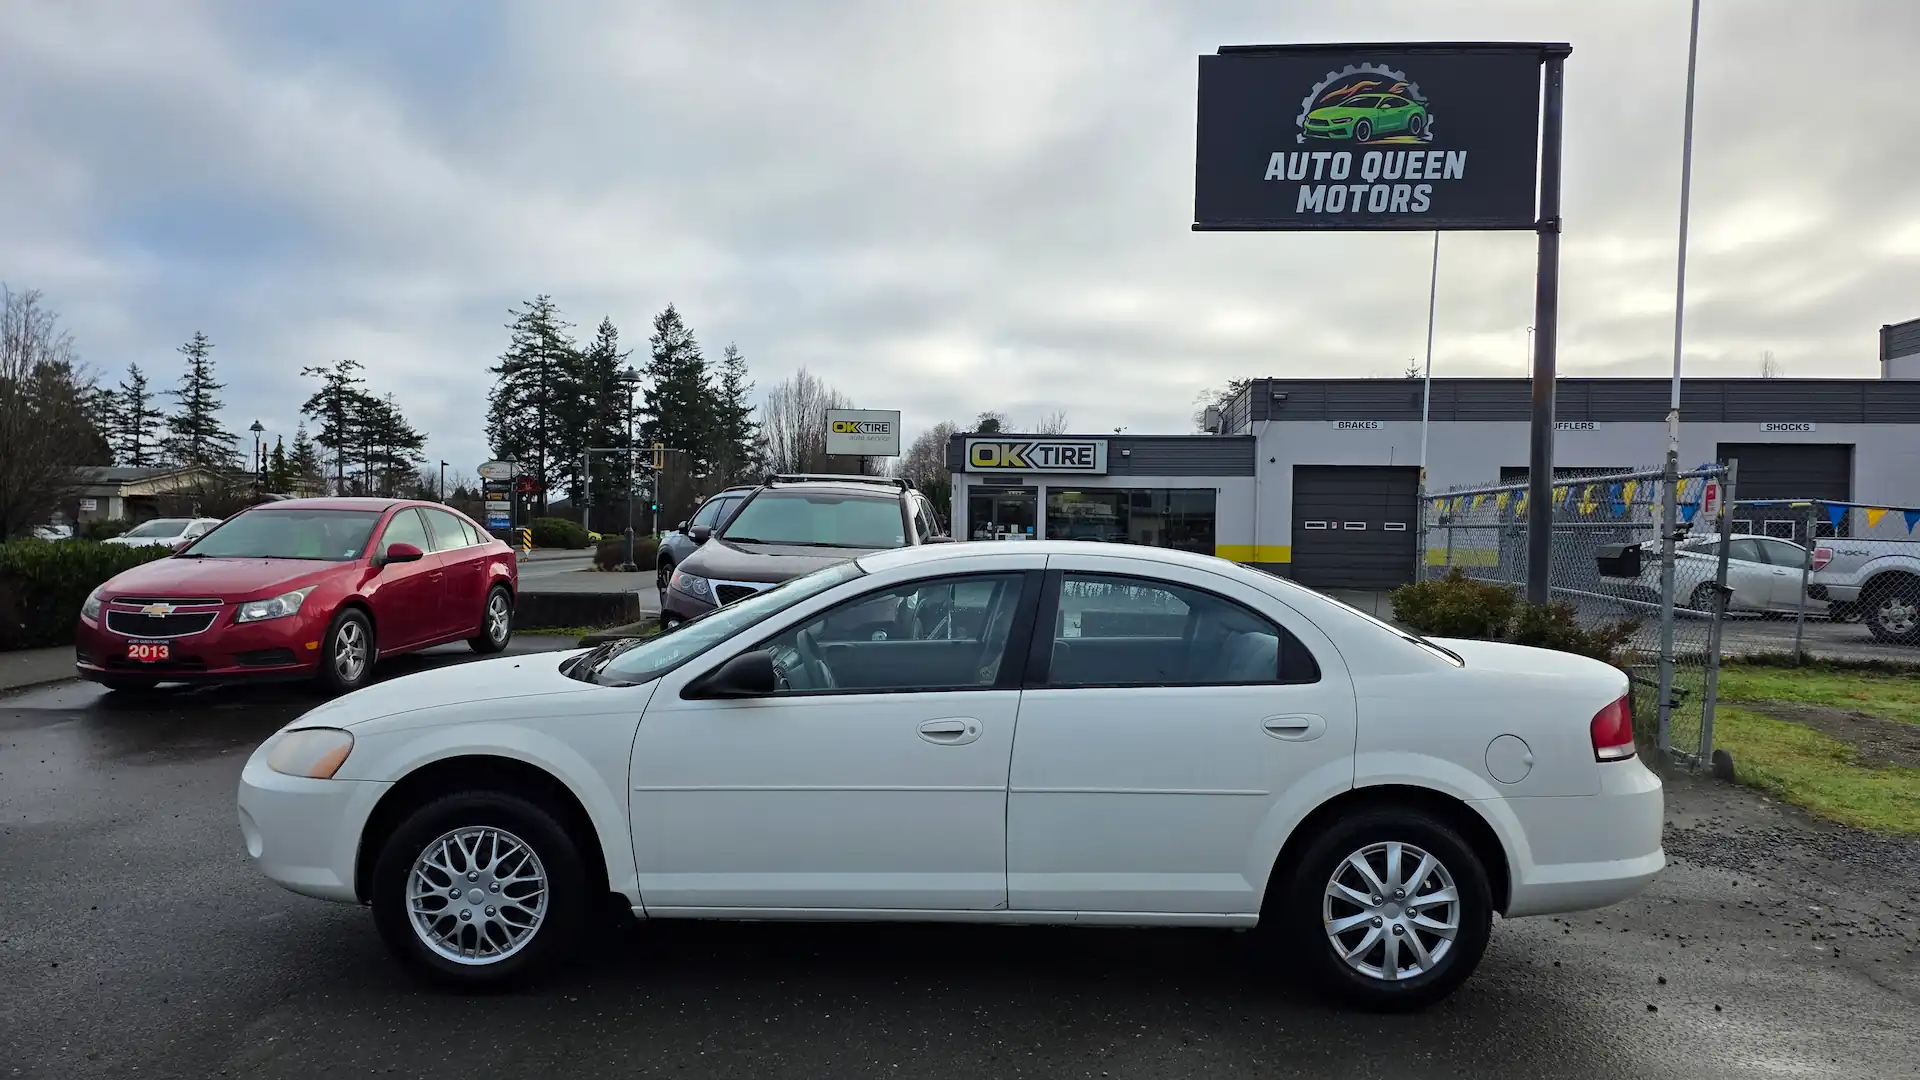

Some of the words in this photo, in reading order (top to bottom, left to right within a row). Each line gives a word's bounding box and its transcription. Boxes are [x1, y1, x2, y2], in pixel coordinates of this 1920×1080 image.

[1264, 151, 1353, 181] AUTO
[1360, 150, 1468, 183] QUEEN
[1296, 183, 1433, 213] MOTORS
[833, 421, 857, 433] OK
[864, 423, 888, 432] TIRE
[1338, 421, 1378, 429] BRAKES
[1553, 422, 1594, 430] UFFLERS
[1766, 423, 1810, 431] SHOCKS
[971, 443, 1028, 467] OK
[1040, 446, 1092, 465] TIRE
[128, 644, 169, 658] 2013
